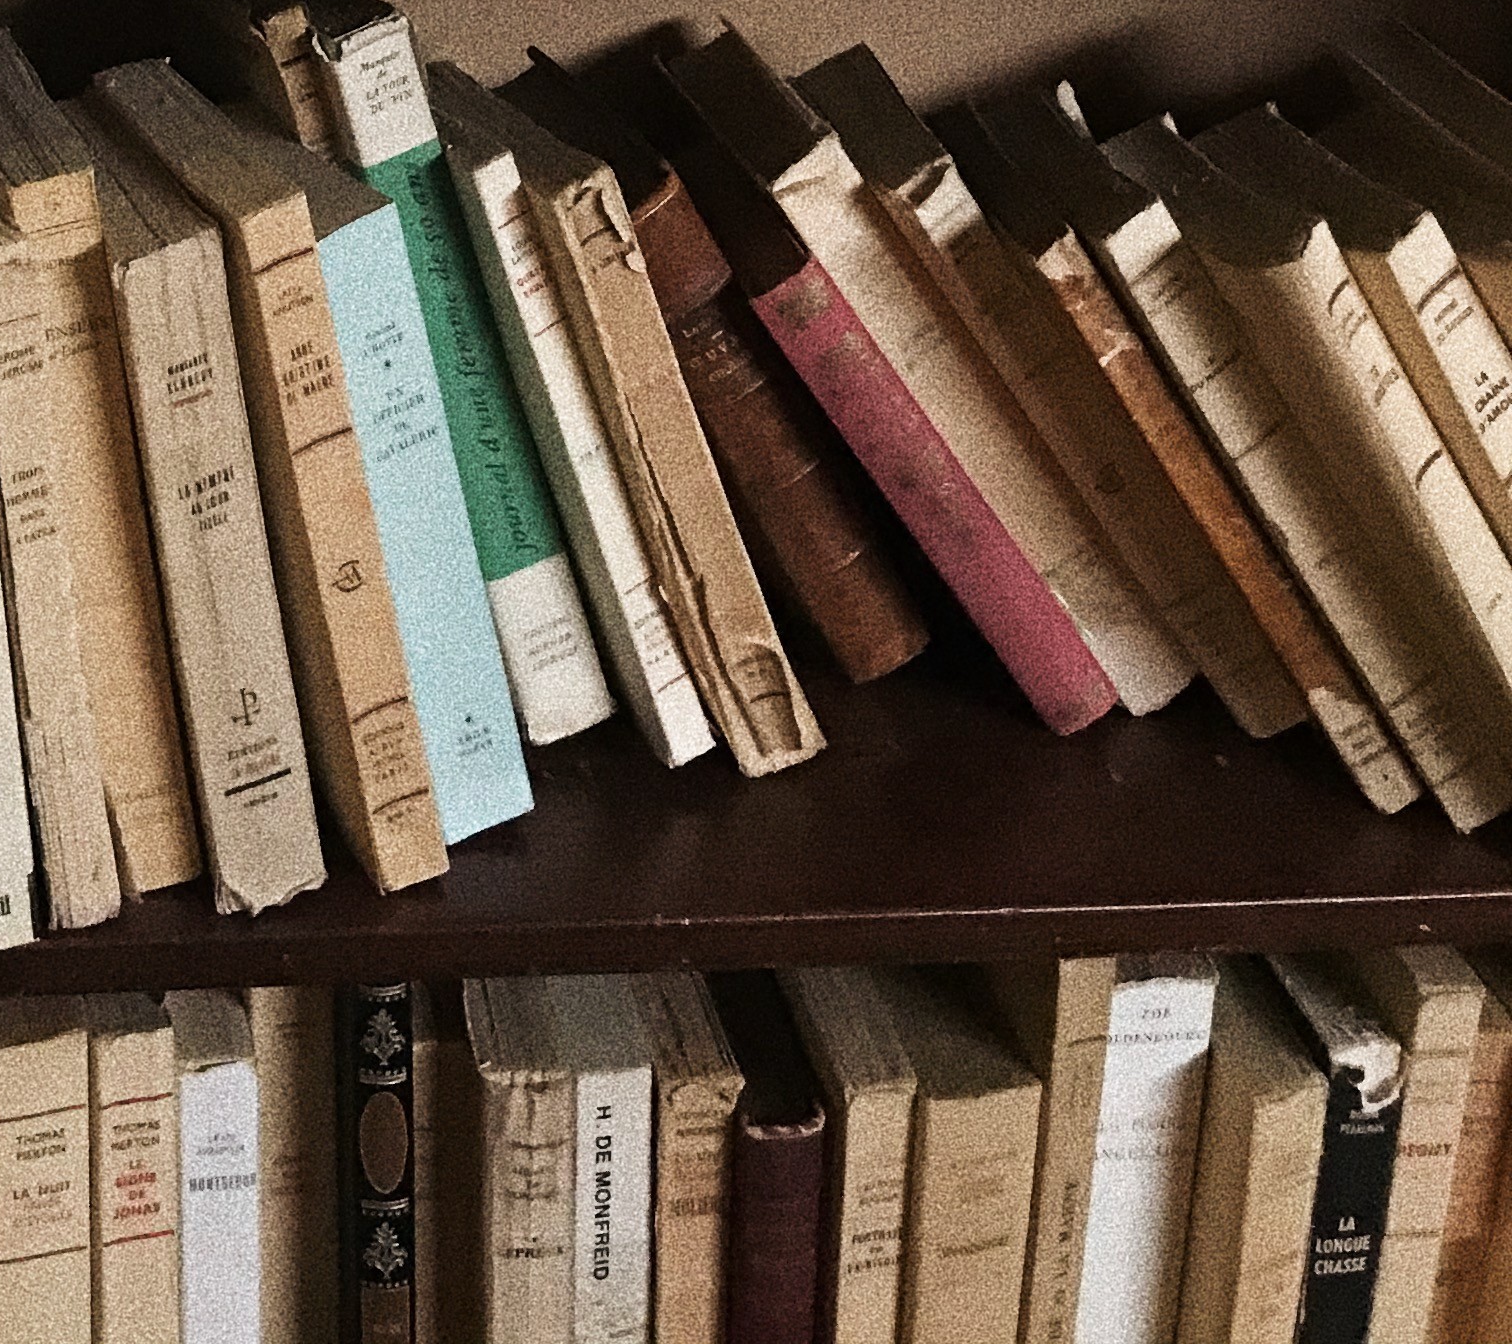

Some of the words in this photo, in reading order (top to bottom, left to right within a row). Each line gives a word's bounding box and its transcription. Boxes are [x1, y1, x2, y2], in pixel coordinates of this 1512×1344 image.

[382, 74, 411, 94] TOUR
[1474, 370, 1489, 387] LA
[486, 463, 539, 554] Journal
[112, 1119, 161, 1136] THOMAS
[111, 1134, 161, 1151] MERTON
[595, 1134, 613, 1163] DE
[16, 1144, 67, 1162] MERTON
[593, 1167, 614, 1282] MONFREID
[1338, 1215, 1357, 1233] LA
[1315, 1233, 1371, 1254] LONGUE
[1313, 1255, 1368, 1275] CHASSE
